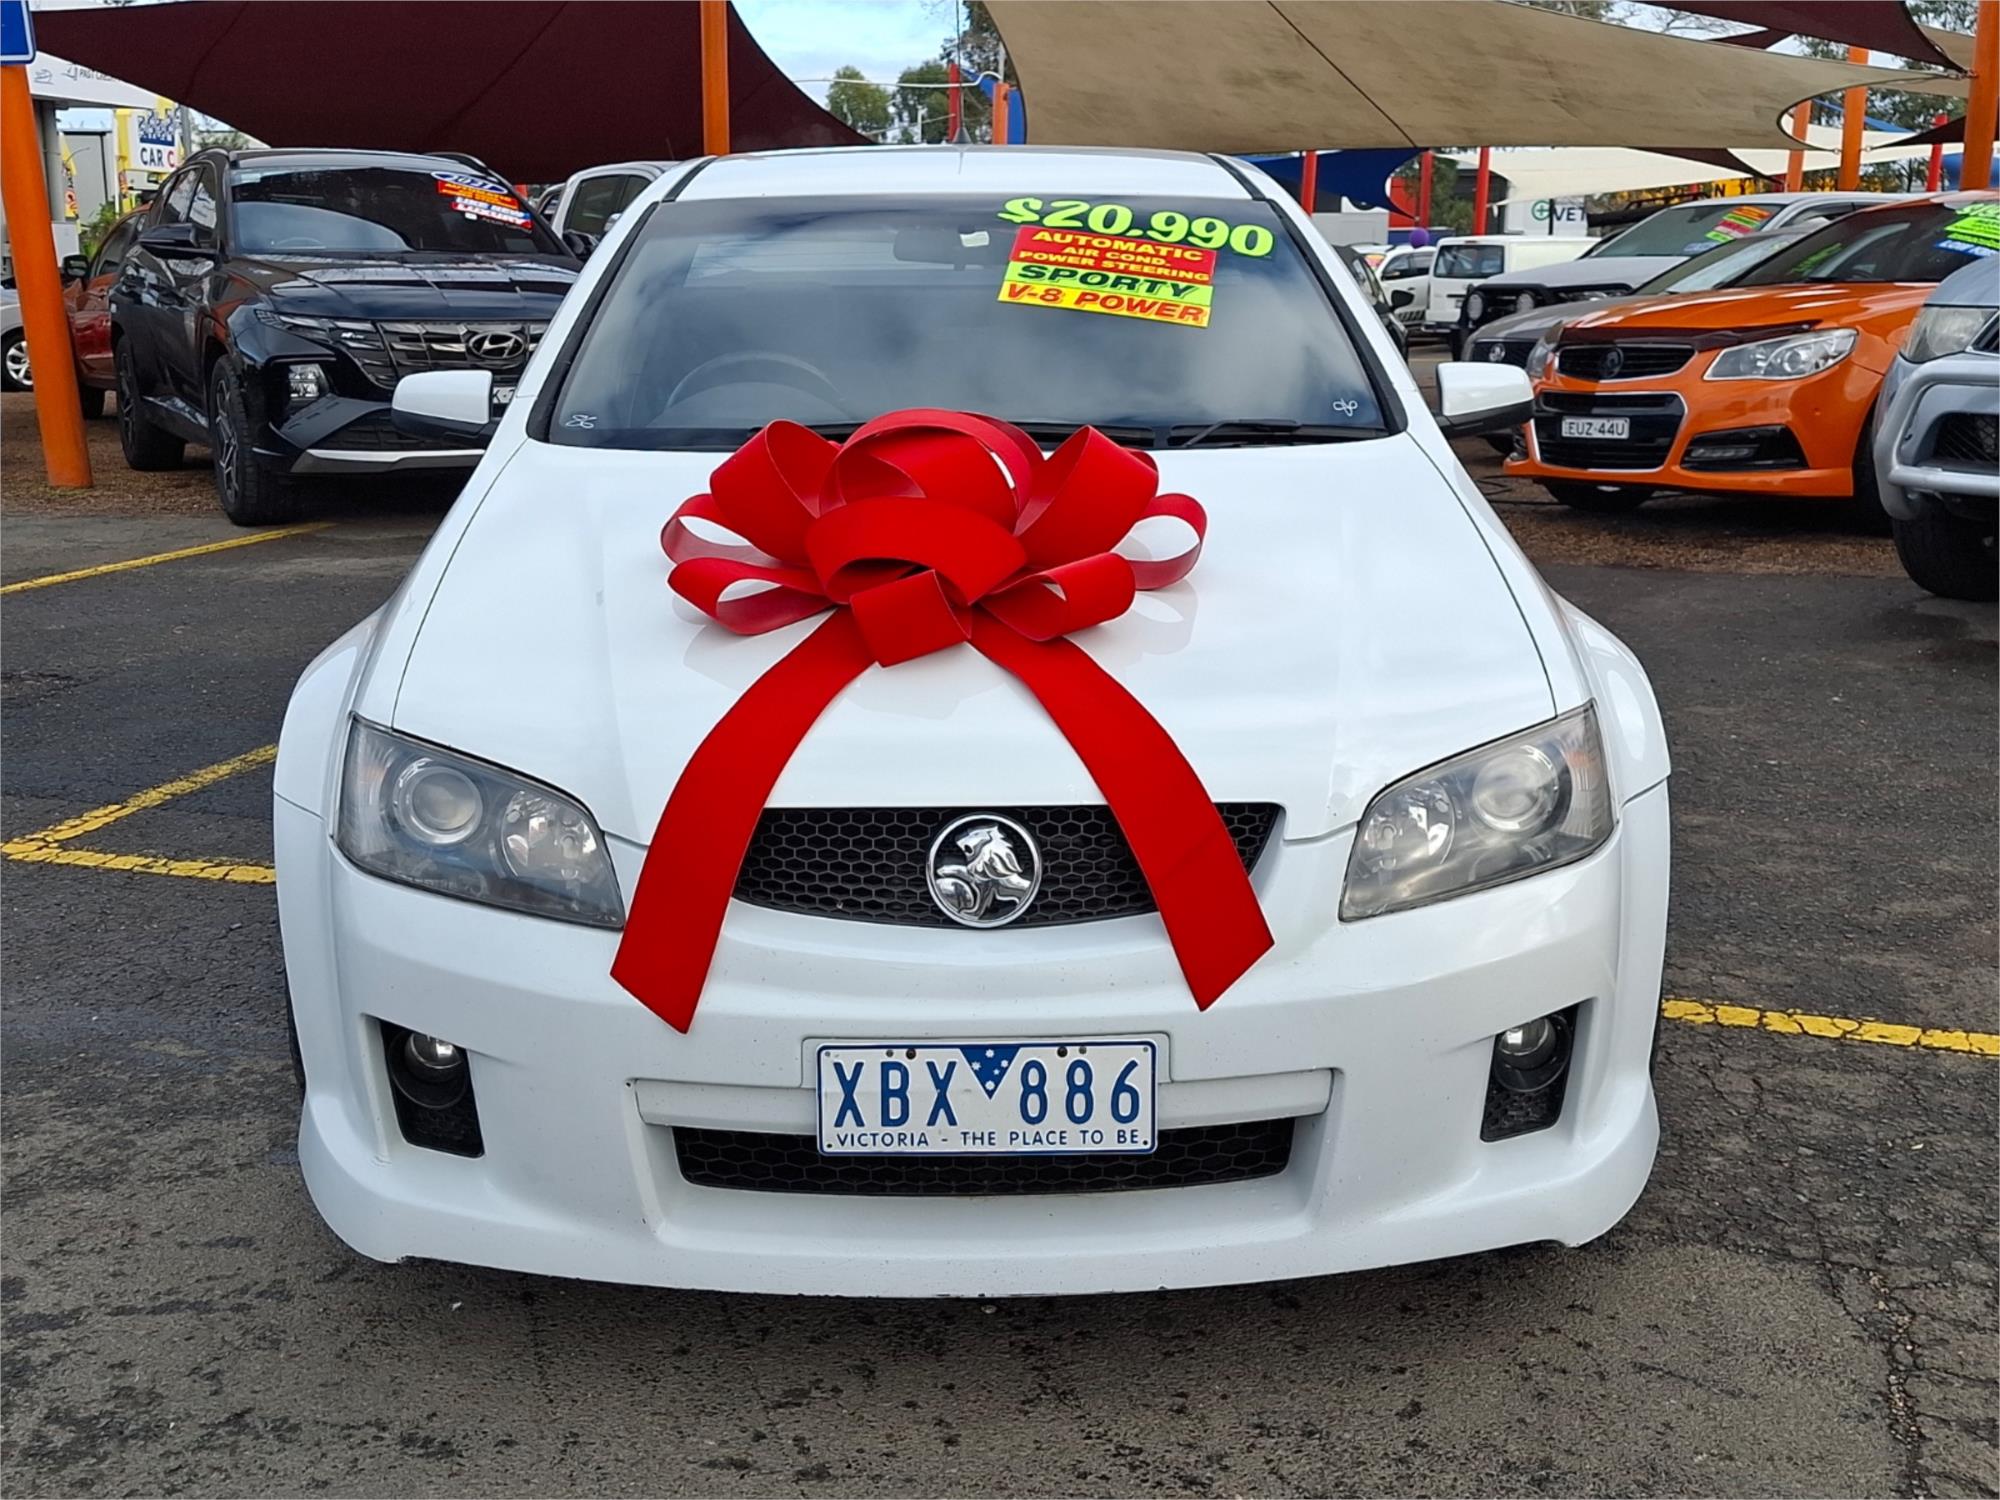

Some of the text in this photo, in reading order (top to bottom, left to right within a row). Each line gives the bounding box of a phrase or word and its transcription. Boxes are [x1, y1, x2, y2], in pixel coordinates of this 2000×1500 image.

[140, 147, 164, 167] CAR
[1031, 231, 1204, 261] AUTOMATIC
[1061, 246, 1172, 267] AIR COND.
[1018, 250, 1210, 281] POWER STEERING
[1017, 264, 1198, 298] SPORTY
[1008, 283, 1206, 323] V-8 POWER
[833, 1059, 1140, 1128] XBX 886
[836, 1132, 929, 1147] VICTORIA
[960, 1131, 996, 1146] THE
[1009, 1130, 1068, 1145] PLACE
[1079, 1129, 1104, 1145] TO
